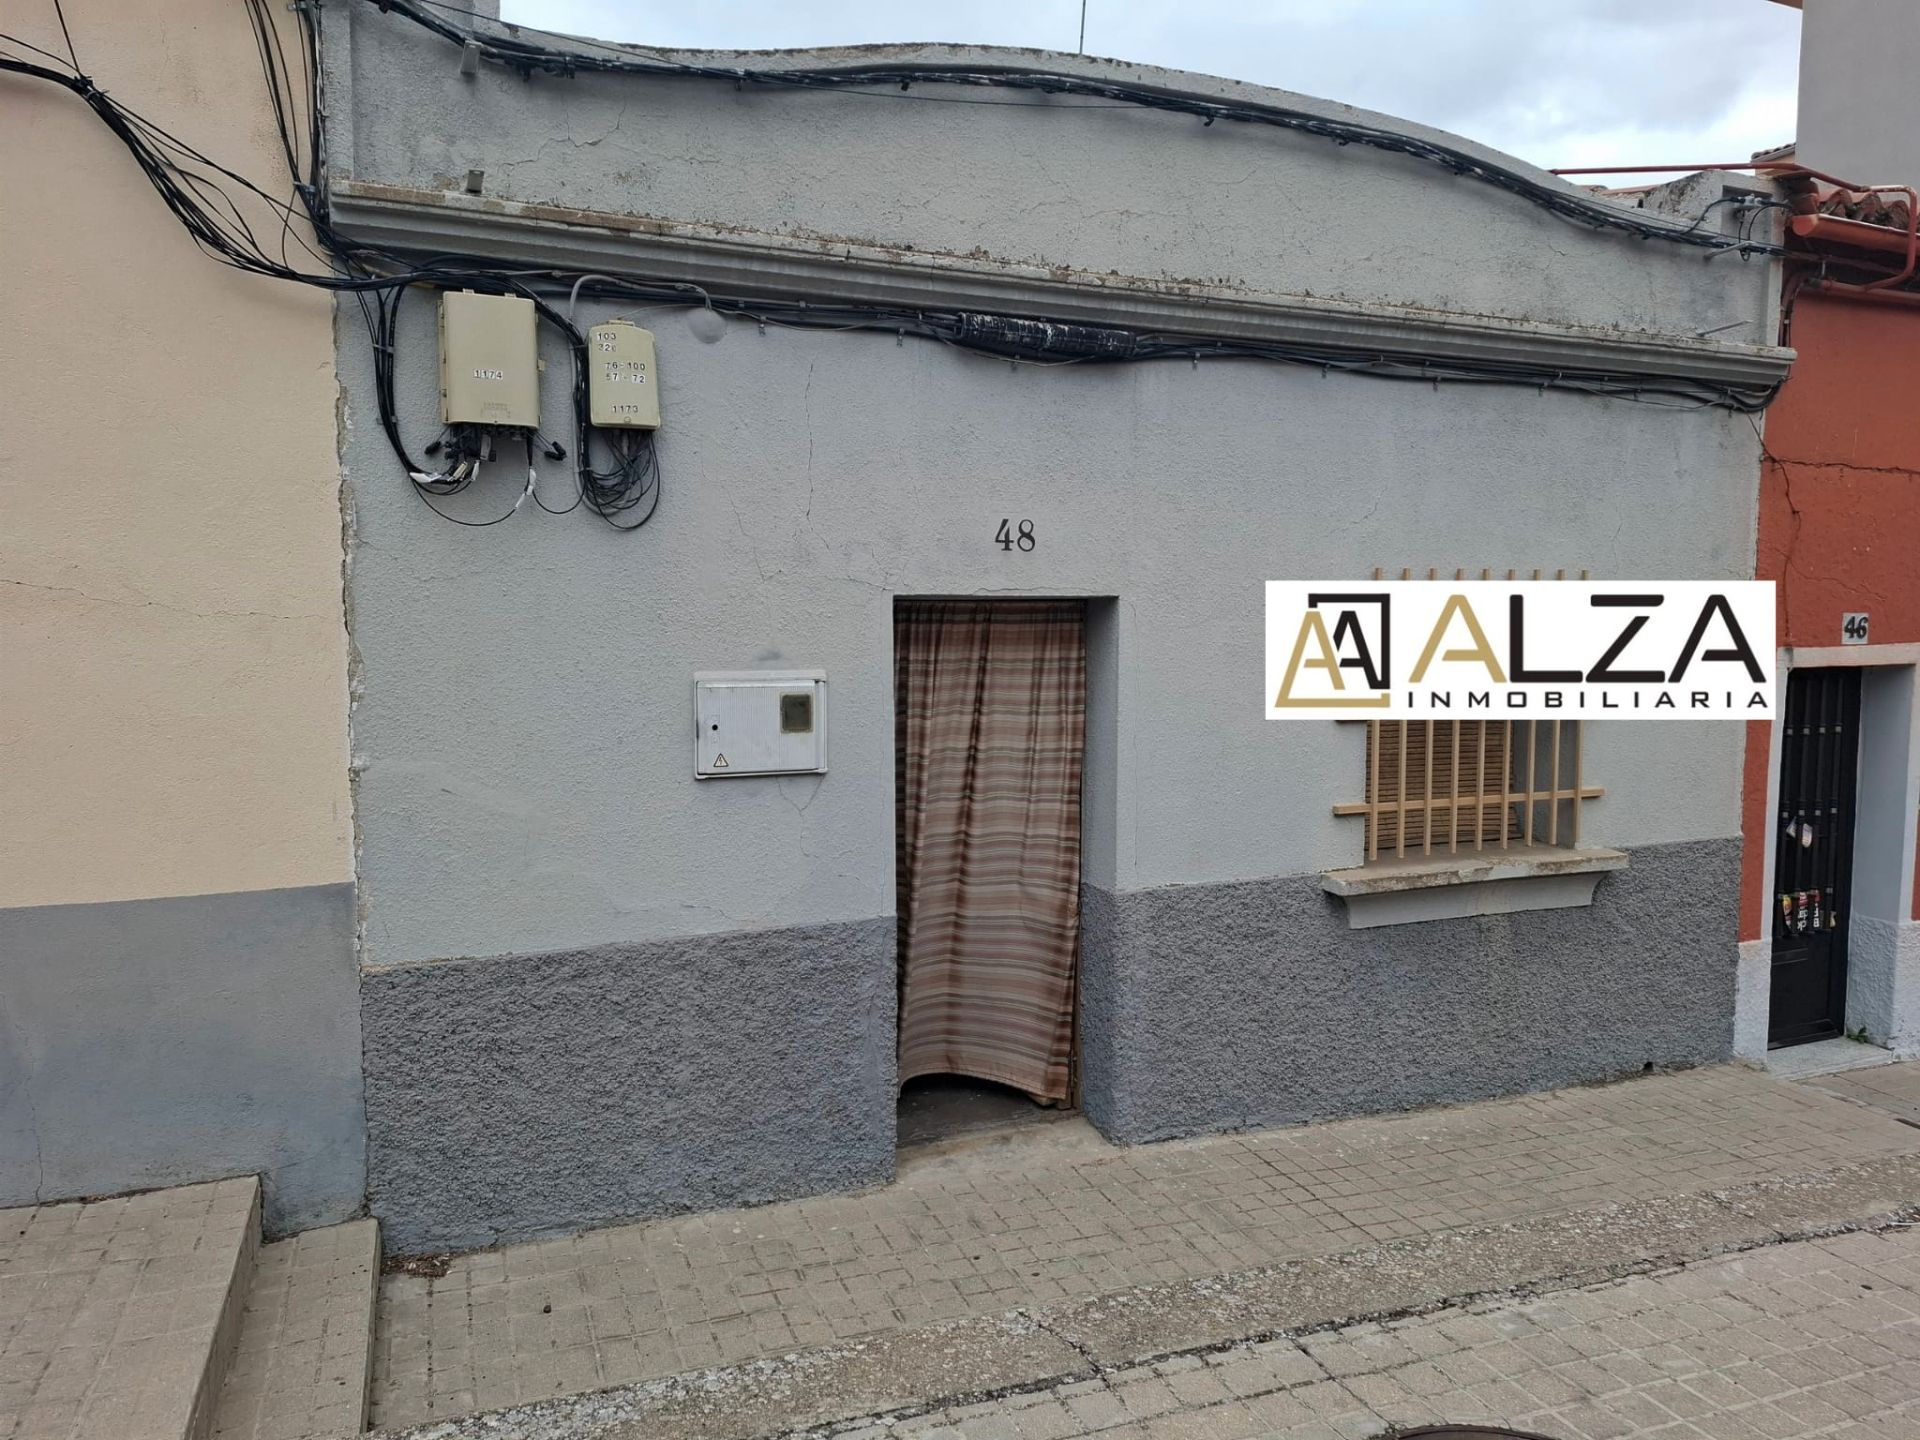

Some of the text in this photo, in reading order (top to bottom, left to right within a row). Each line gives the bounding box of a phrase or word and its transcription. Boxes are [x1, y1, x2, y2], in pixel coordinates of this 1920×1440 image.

[598, 332, 617, 341] 103
[474, 369, 503, 379] 1174
[612, 404, 640, 414] 1173
[995, 518, 1036, 553] 48
[1844, 615, 1869, 639] 46
